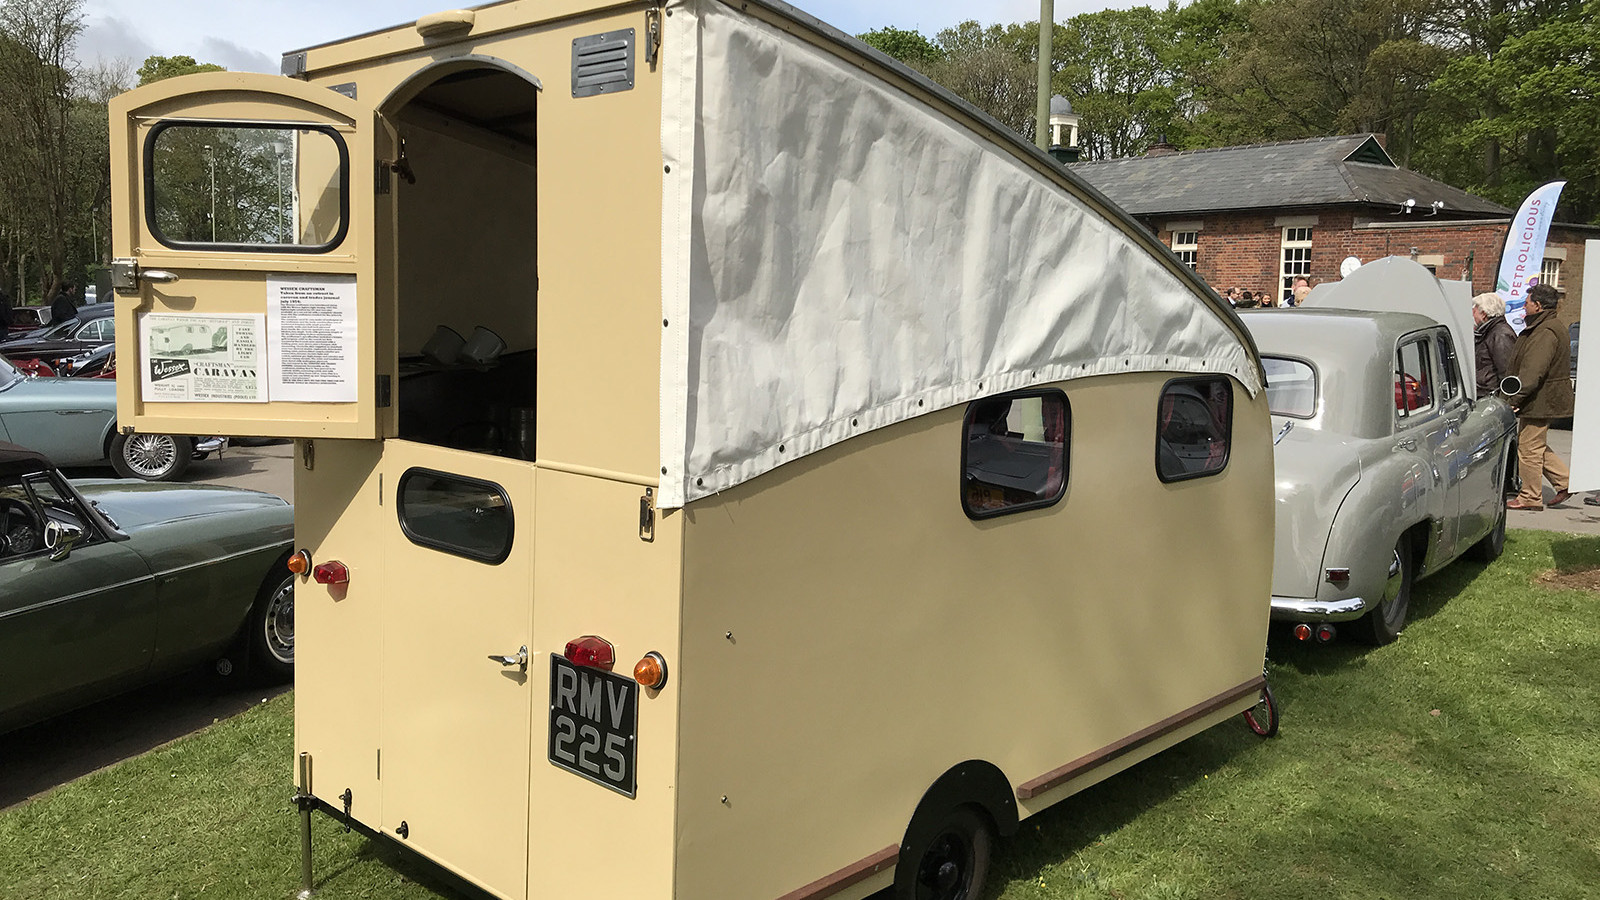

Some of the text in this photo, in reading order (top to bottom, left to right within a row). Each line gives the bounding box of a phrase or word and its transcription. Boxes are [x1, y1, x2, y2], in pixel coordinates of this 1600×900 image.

[1511, 199, 1541, 296] PETROLICIOUS
[154, 361, 188, 376] Wessex
[193, 368, 256, 377] CARAVAN
[557, 664, 628, 729] RMV
[555, 715, 626, 782] 225
